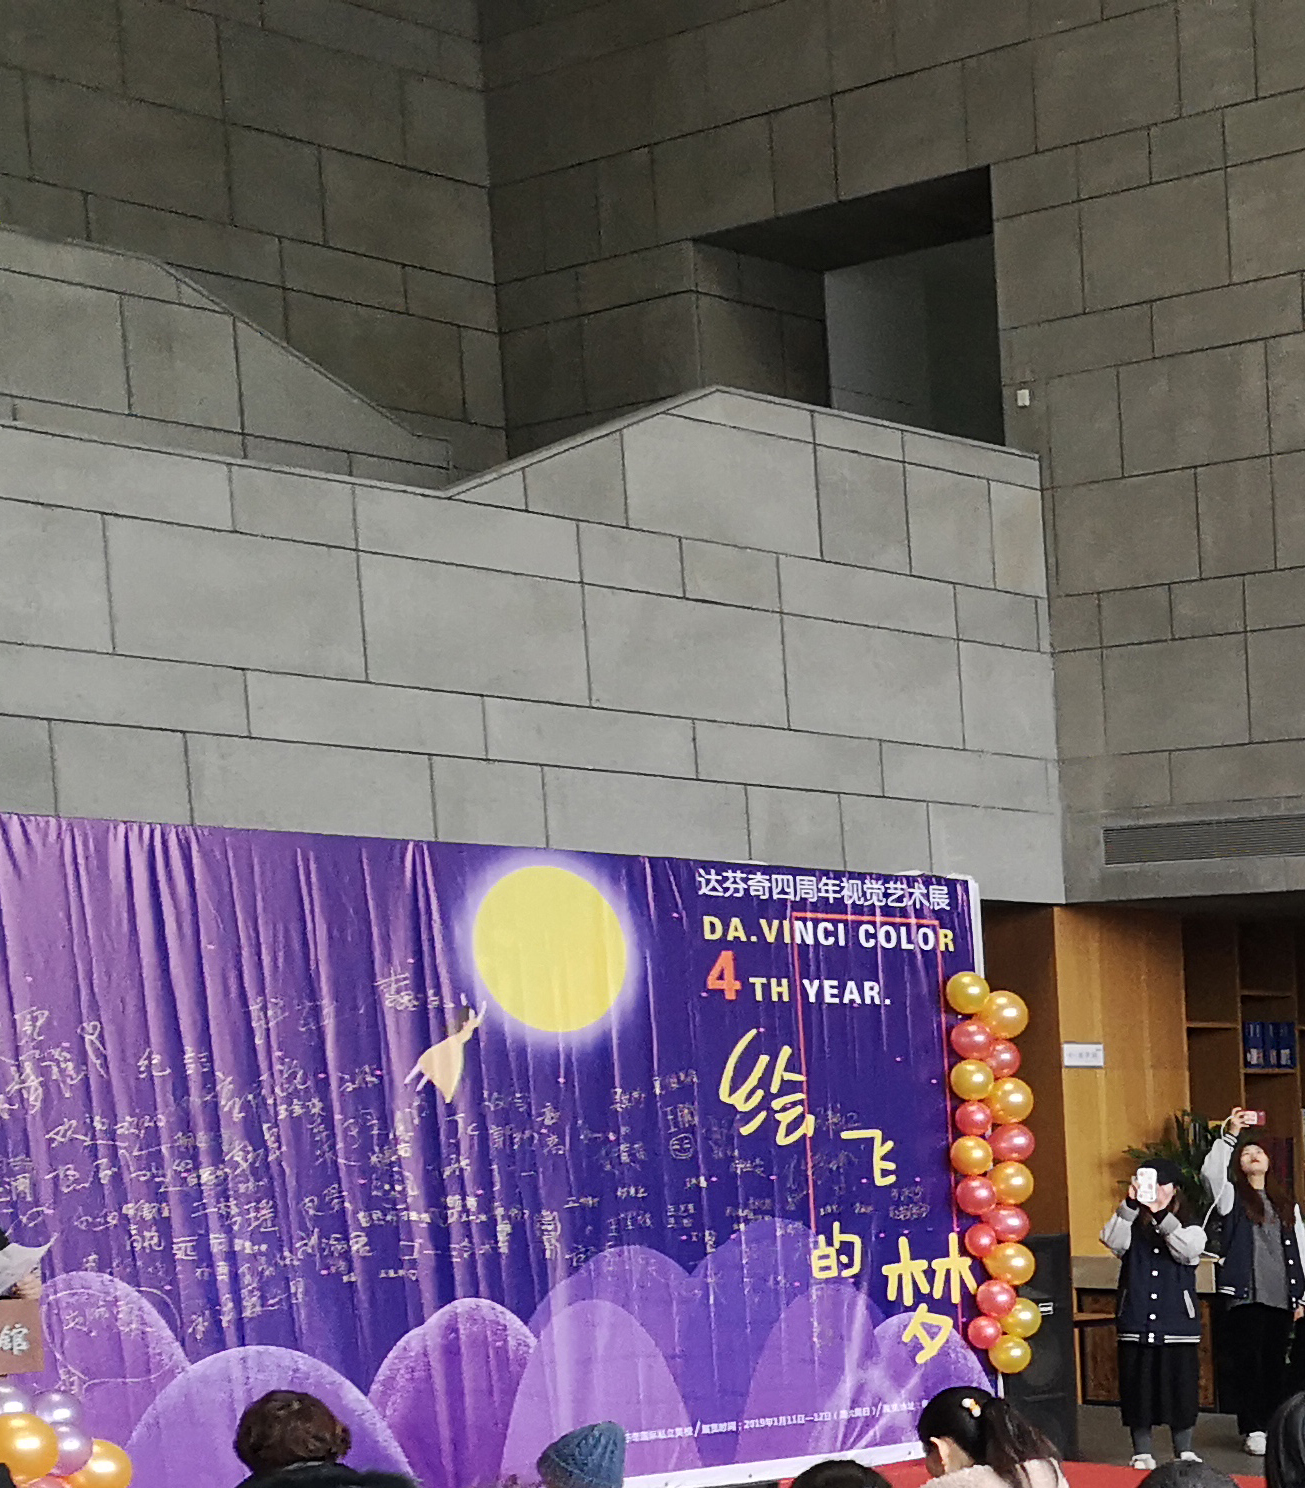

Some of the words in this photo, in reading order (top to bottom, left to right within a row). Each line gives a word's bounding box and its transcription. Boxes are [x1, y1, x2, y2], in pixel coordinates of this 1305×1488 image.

[697, 869, 951, 911] 达芬奇四周年视觉艺术展
[702, 915, 846, 946] DA.VINCI
[858, 923, 955, 952] COLOR
[706, 950, 742, 1001] 4
[748, 977, 790, 1002] TH
[802, 979, 891, 1005] YEAR.
[718, 1028, 815, 1146] 绘
[840, 1129, 897, 1187] 飞
[811, 1221, 862, 1280] 的
[881, 1232, 978, 1364] 梦
